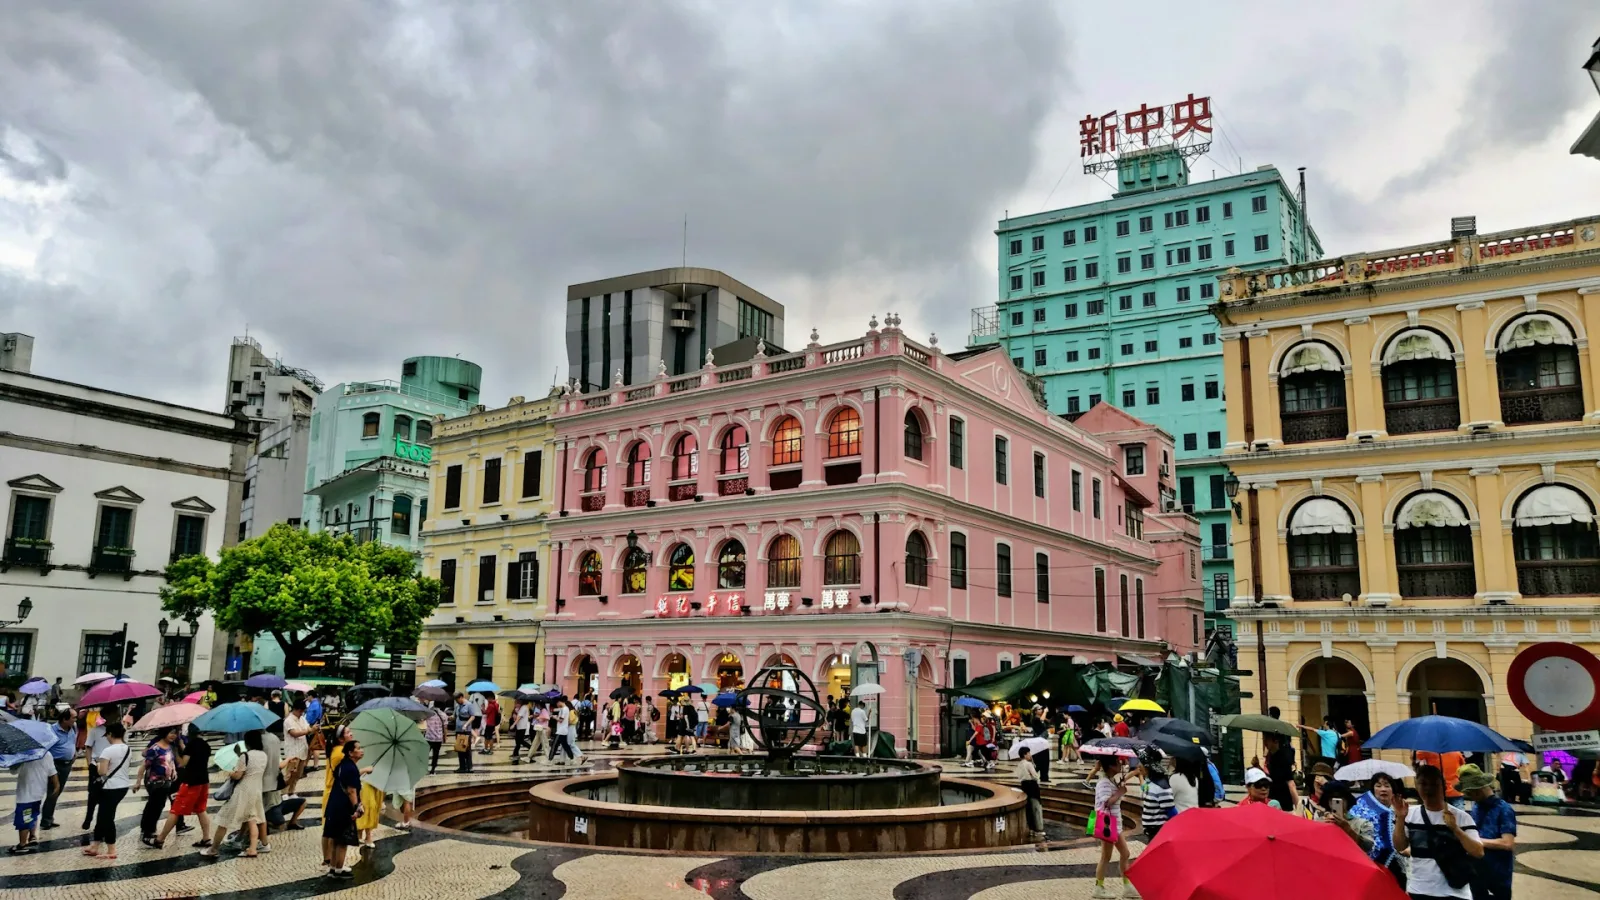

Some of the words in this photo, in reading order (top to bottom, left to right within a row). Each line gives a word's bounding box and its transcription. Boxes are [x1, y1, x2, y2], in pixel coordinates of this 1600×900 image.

[1079, 93, 1213, 157] 新中央
[764, 591, 790, 610] 萬寧
[821, 589, 849, 609] 萬寧
